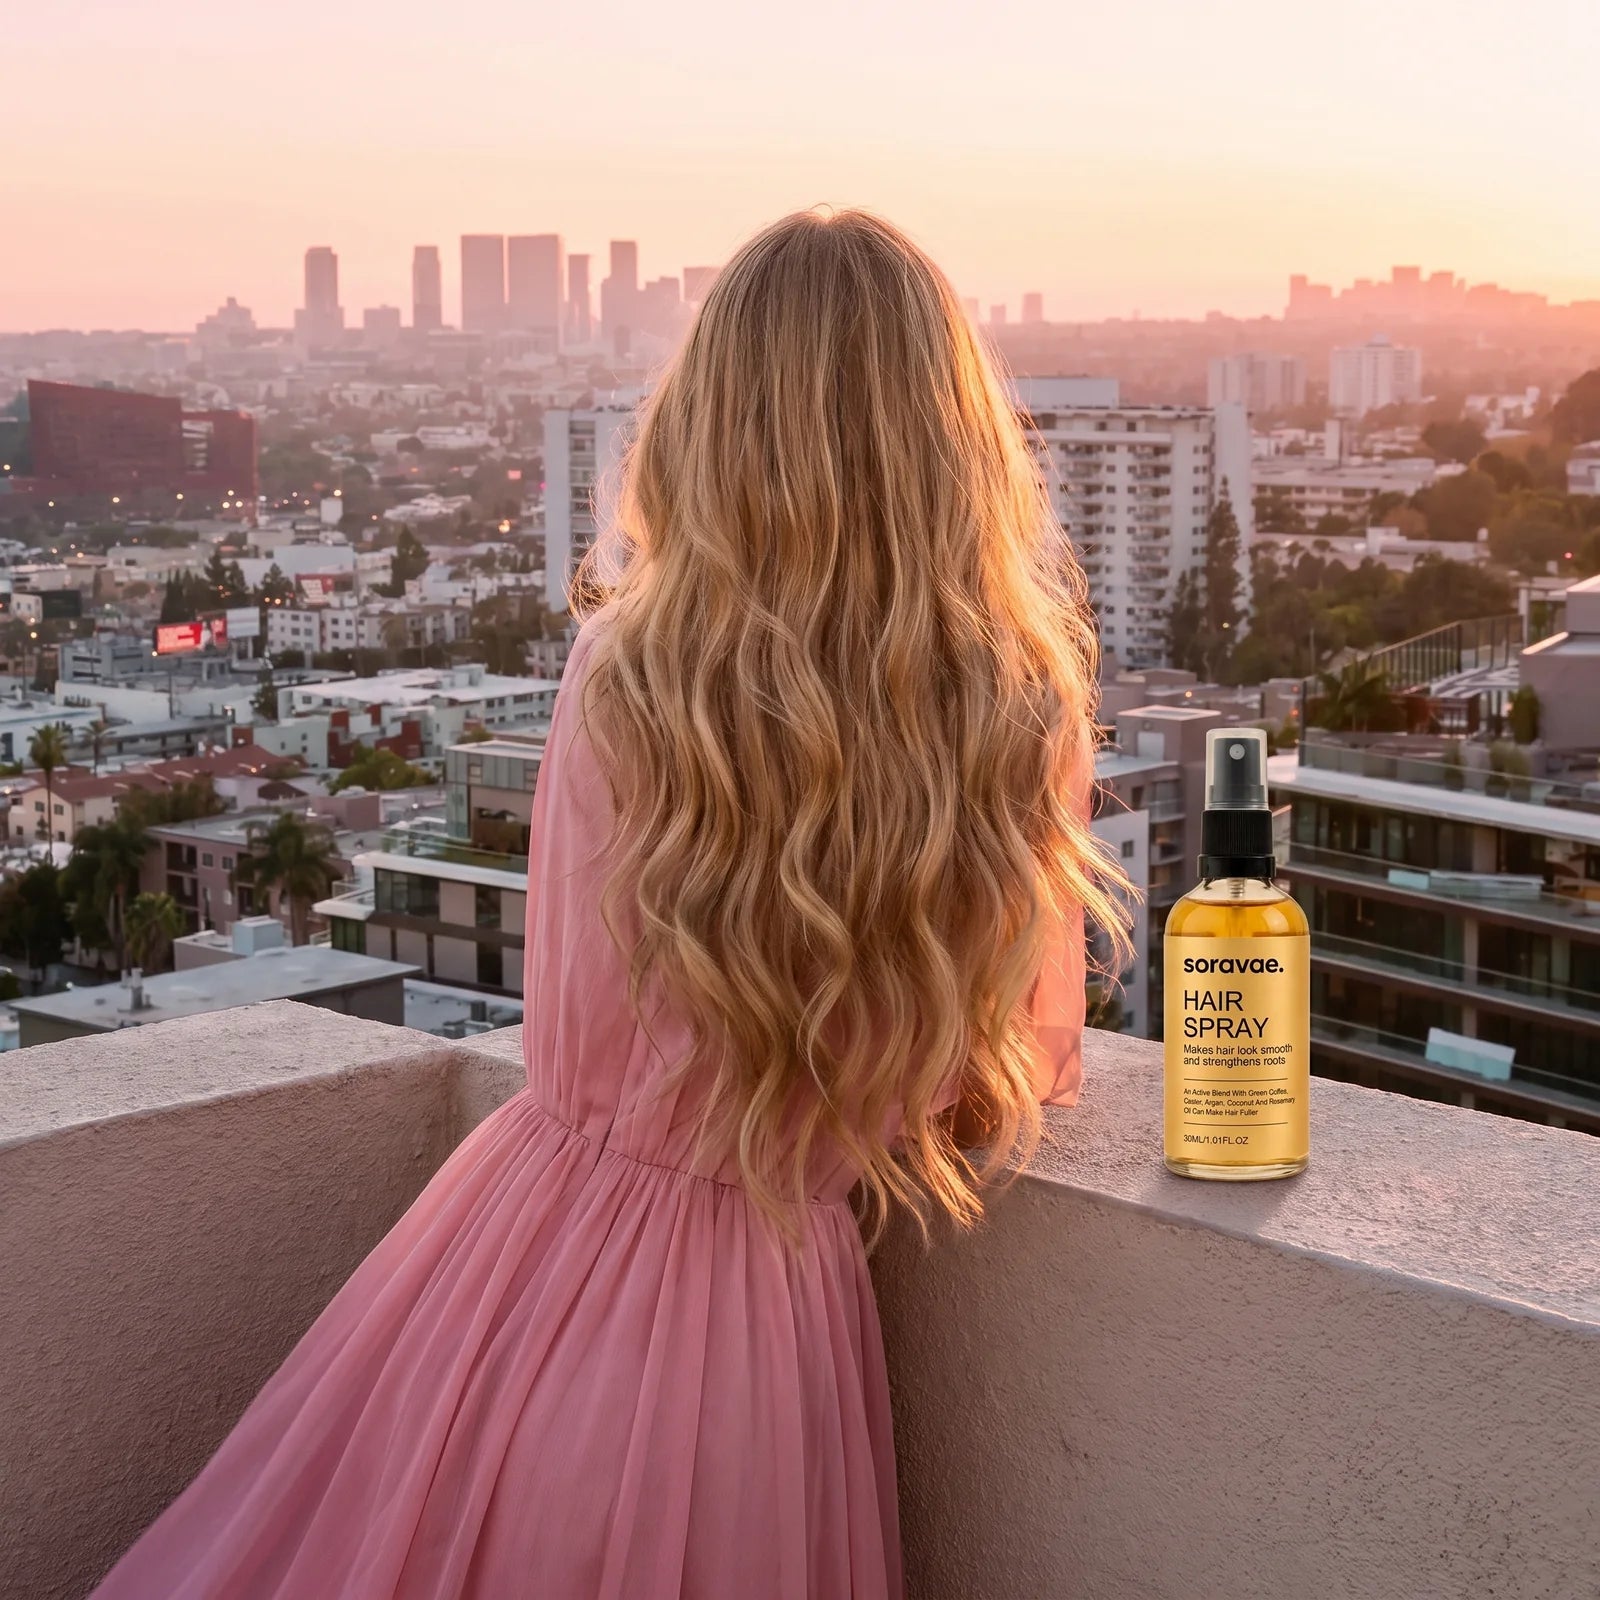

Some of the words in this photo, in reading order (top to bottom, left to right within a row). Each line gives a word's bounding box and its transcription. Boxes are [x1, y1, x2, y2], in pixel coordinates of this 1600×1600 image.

[1184, 957, 1284, 973] soravae.
[1184, 990, 1244, 1011] HAIR
[1184, 1017, 1269, 1038] SPRAY
[1184, 1044, 1214, 1055] Makes
[1216, 1044, 1235, 1055] hair
[1237, 1045, 1258, 1055] look
[1260, 1044, 1293, 1055] smooth
[1184, 1056, 1200, 1066] and
[1203, 1056, 1261, 1069] strengthens
[1263, 1056, 1286, 1066] roots
[1184, 1135, 1249, 1144] 30ML/1.01FL.OZ
